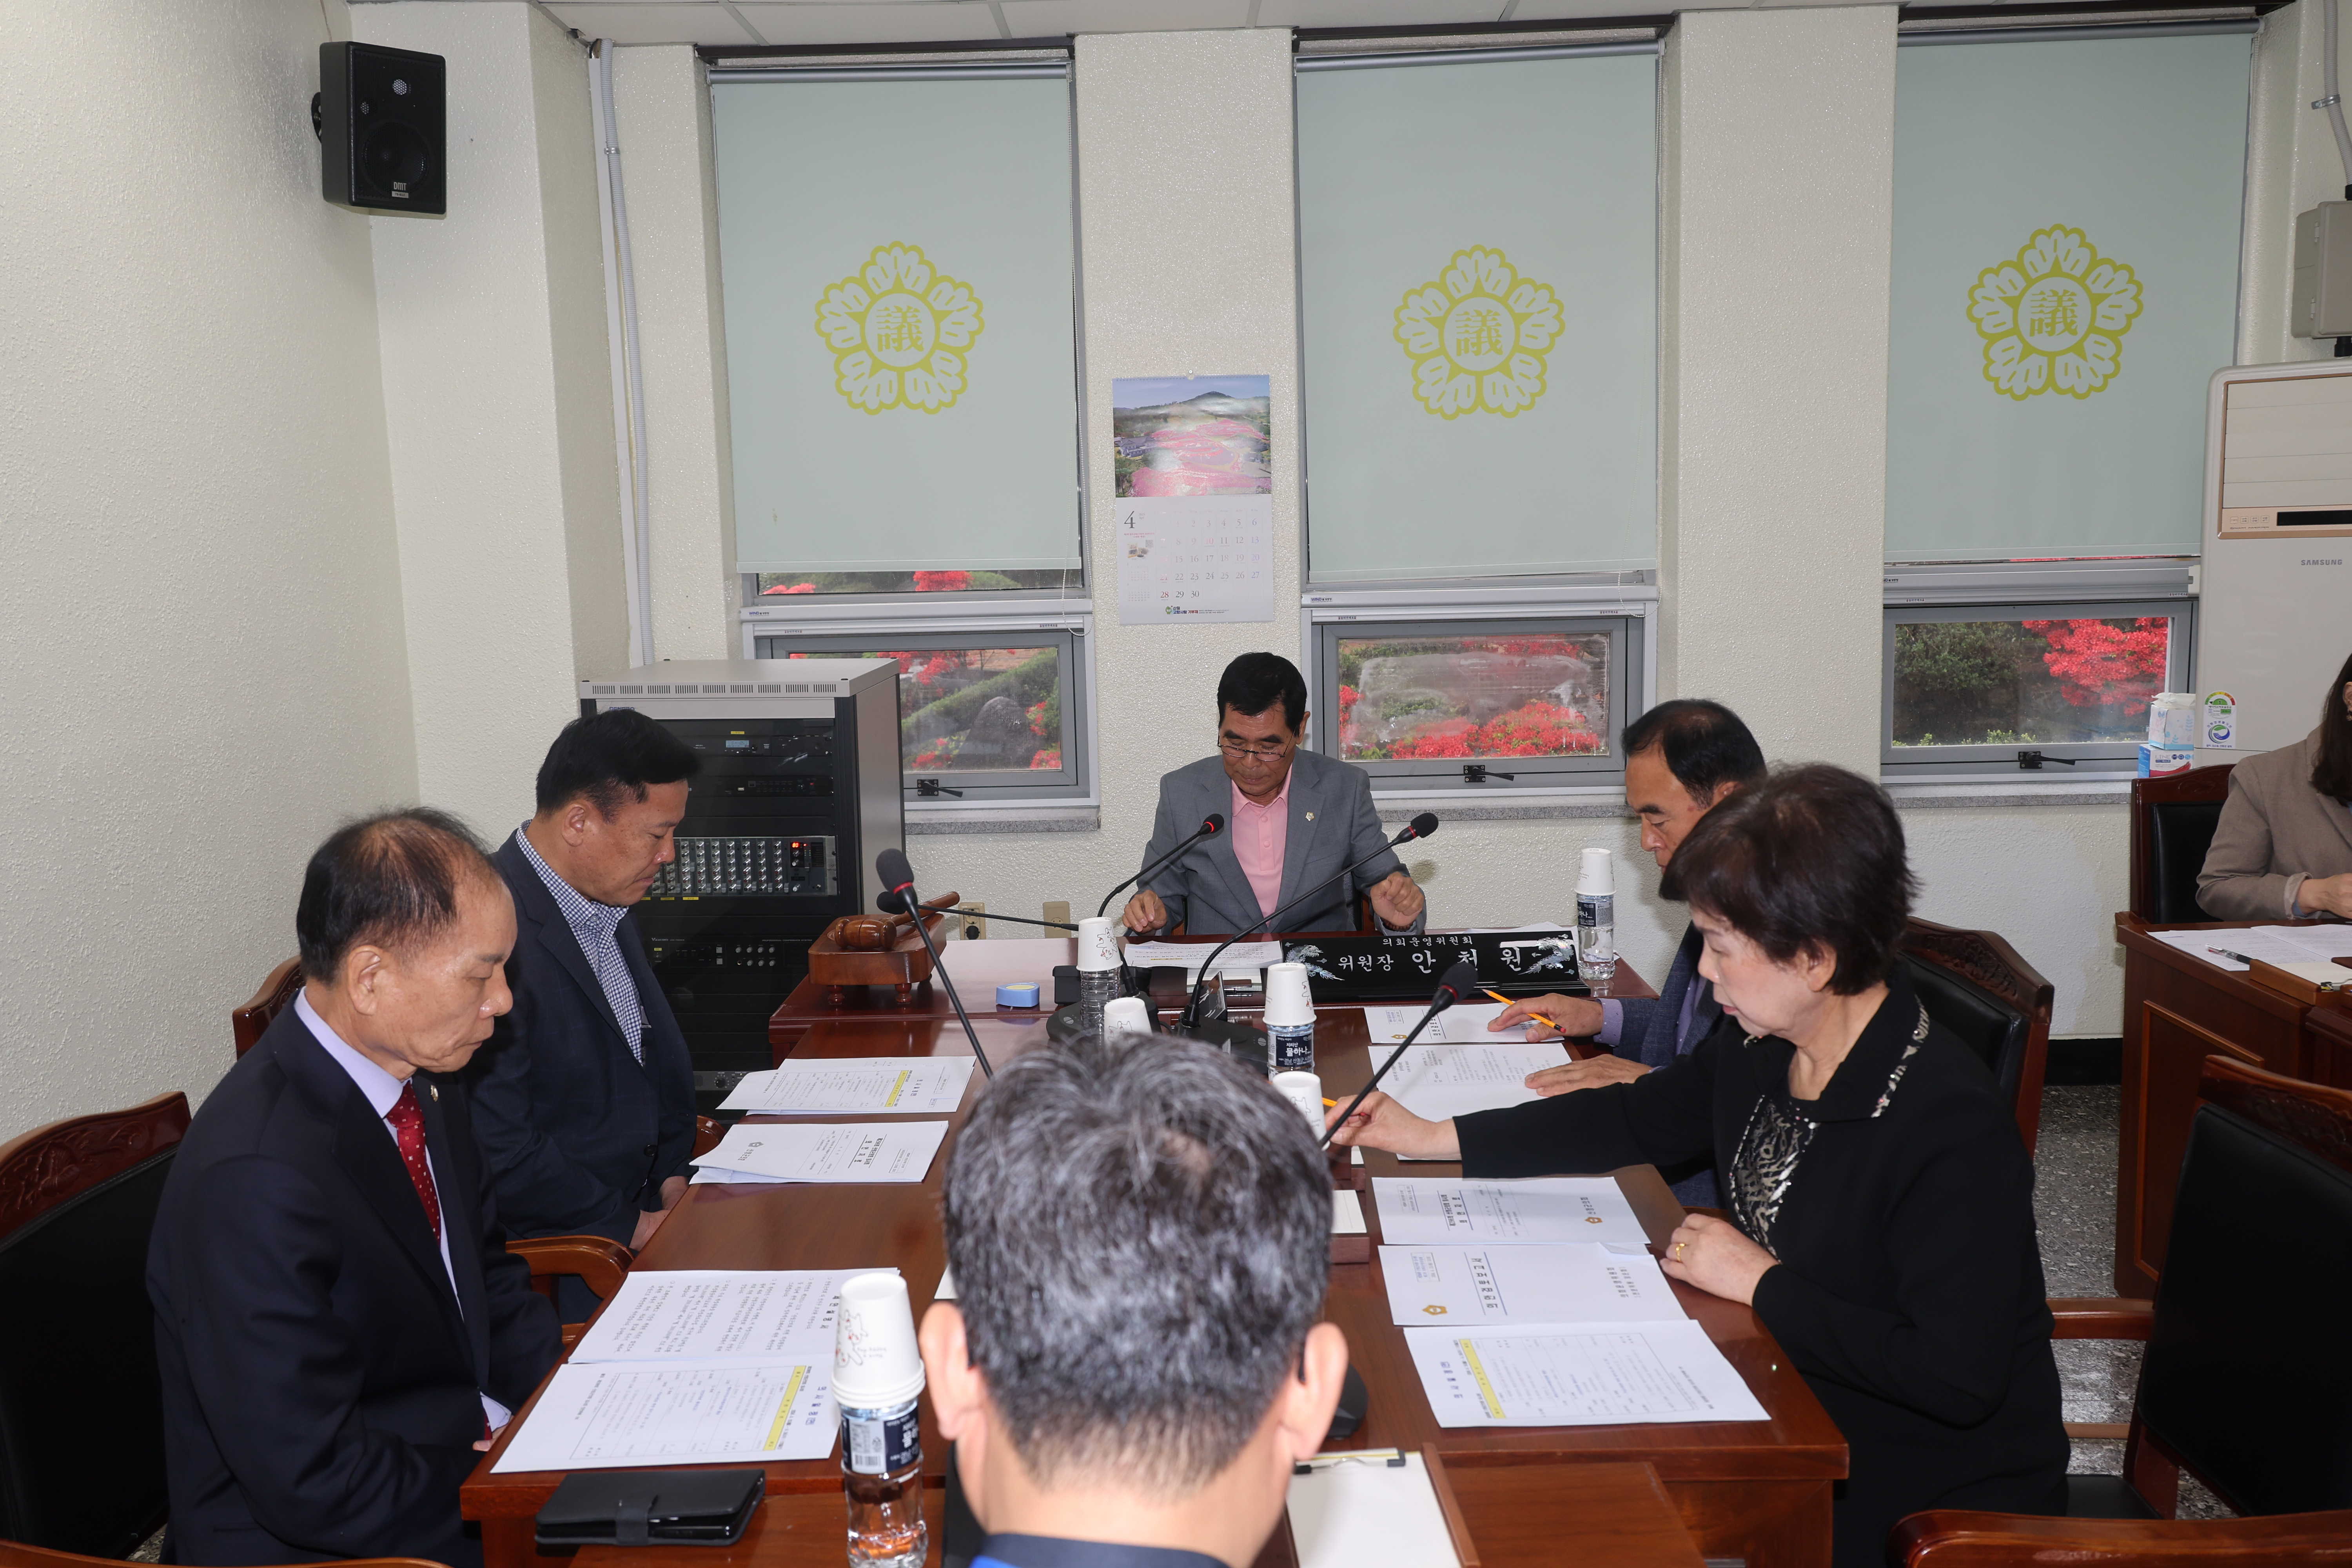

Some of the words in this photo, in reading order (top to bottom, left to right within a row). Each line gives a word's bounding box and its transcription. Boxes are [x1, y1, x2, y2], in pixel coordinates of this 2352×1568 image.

[2029, 289, 2078, 337] 議
[876, 305, 924, 352] 議
[1455, 309, 1503, 357] 議
[1124, 511, 1136, 528] 4
[1383, 936, 1473, 947] 의회운영위원회
[1338, 955, 1394, 973] 위원장
[1286, 1046, 1308, 1057] 물하나
